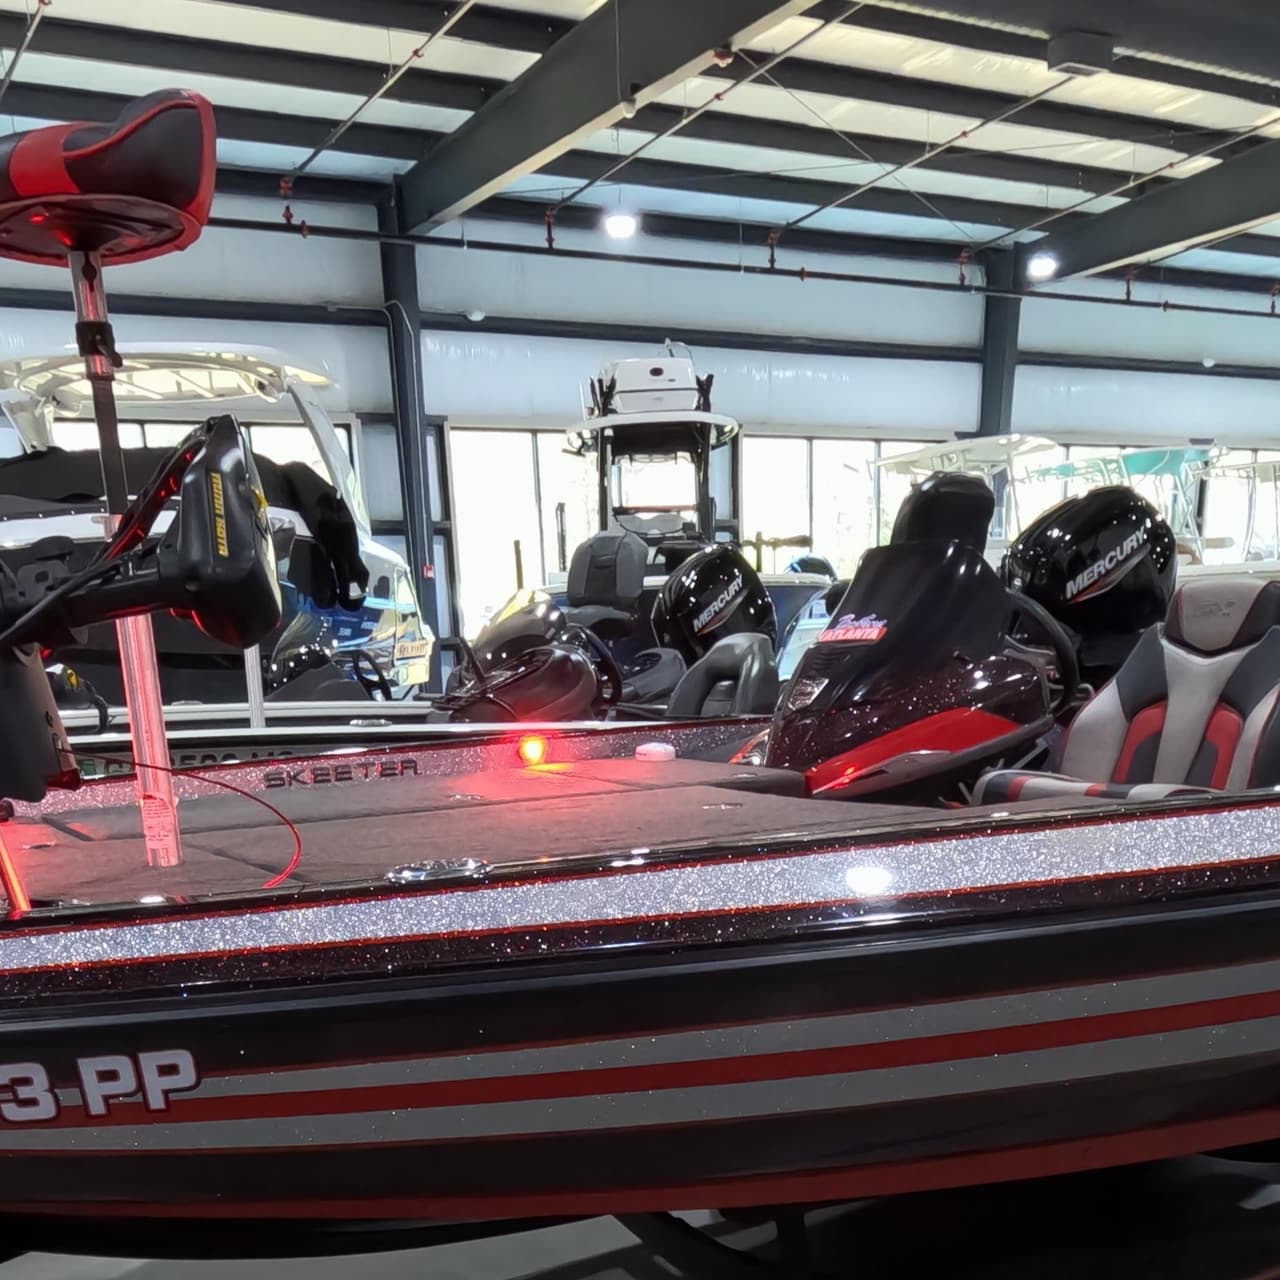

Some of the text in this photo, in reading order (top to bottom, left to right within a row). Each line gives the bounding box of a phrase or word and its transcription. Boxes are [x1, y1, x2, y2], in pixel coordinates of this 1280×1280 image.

[1066, 525, 1145, 599] MERCURY
[693, 573, 742, 632] MERCURY
[264, 759, 419, 788] SKEETER
[77, 1049, 198, 1116] PP
